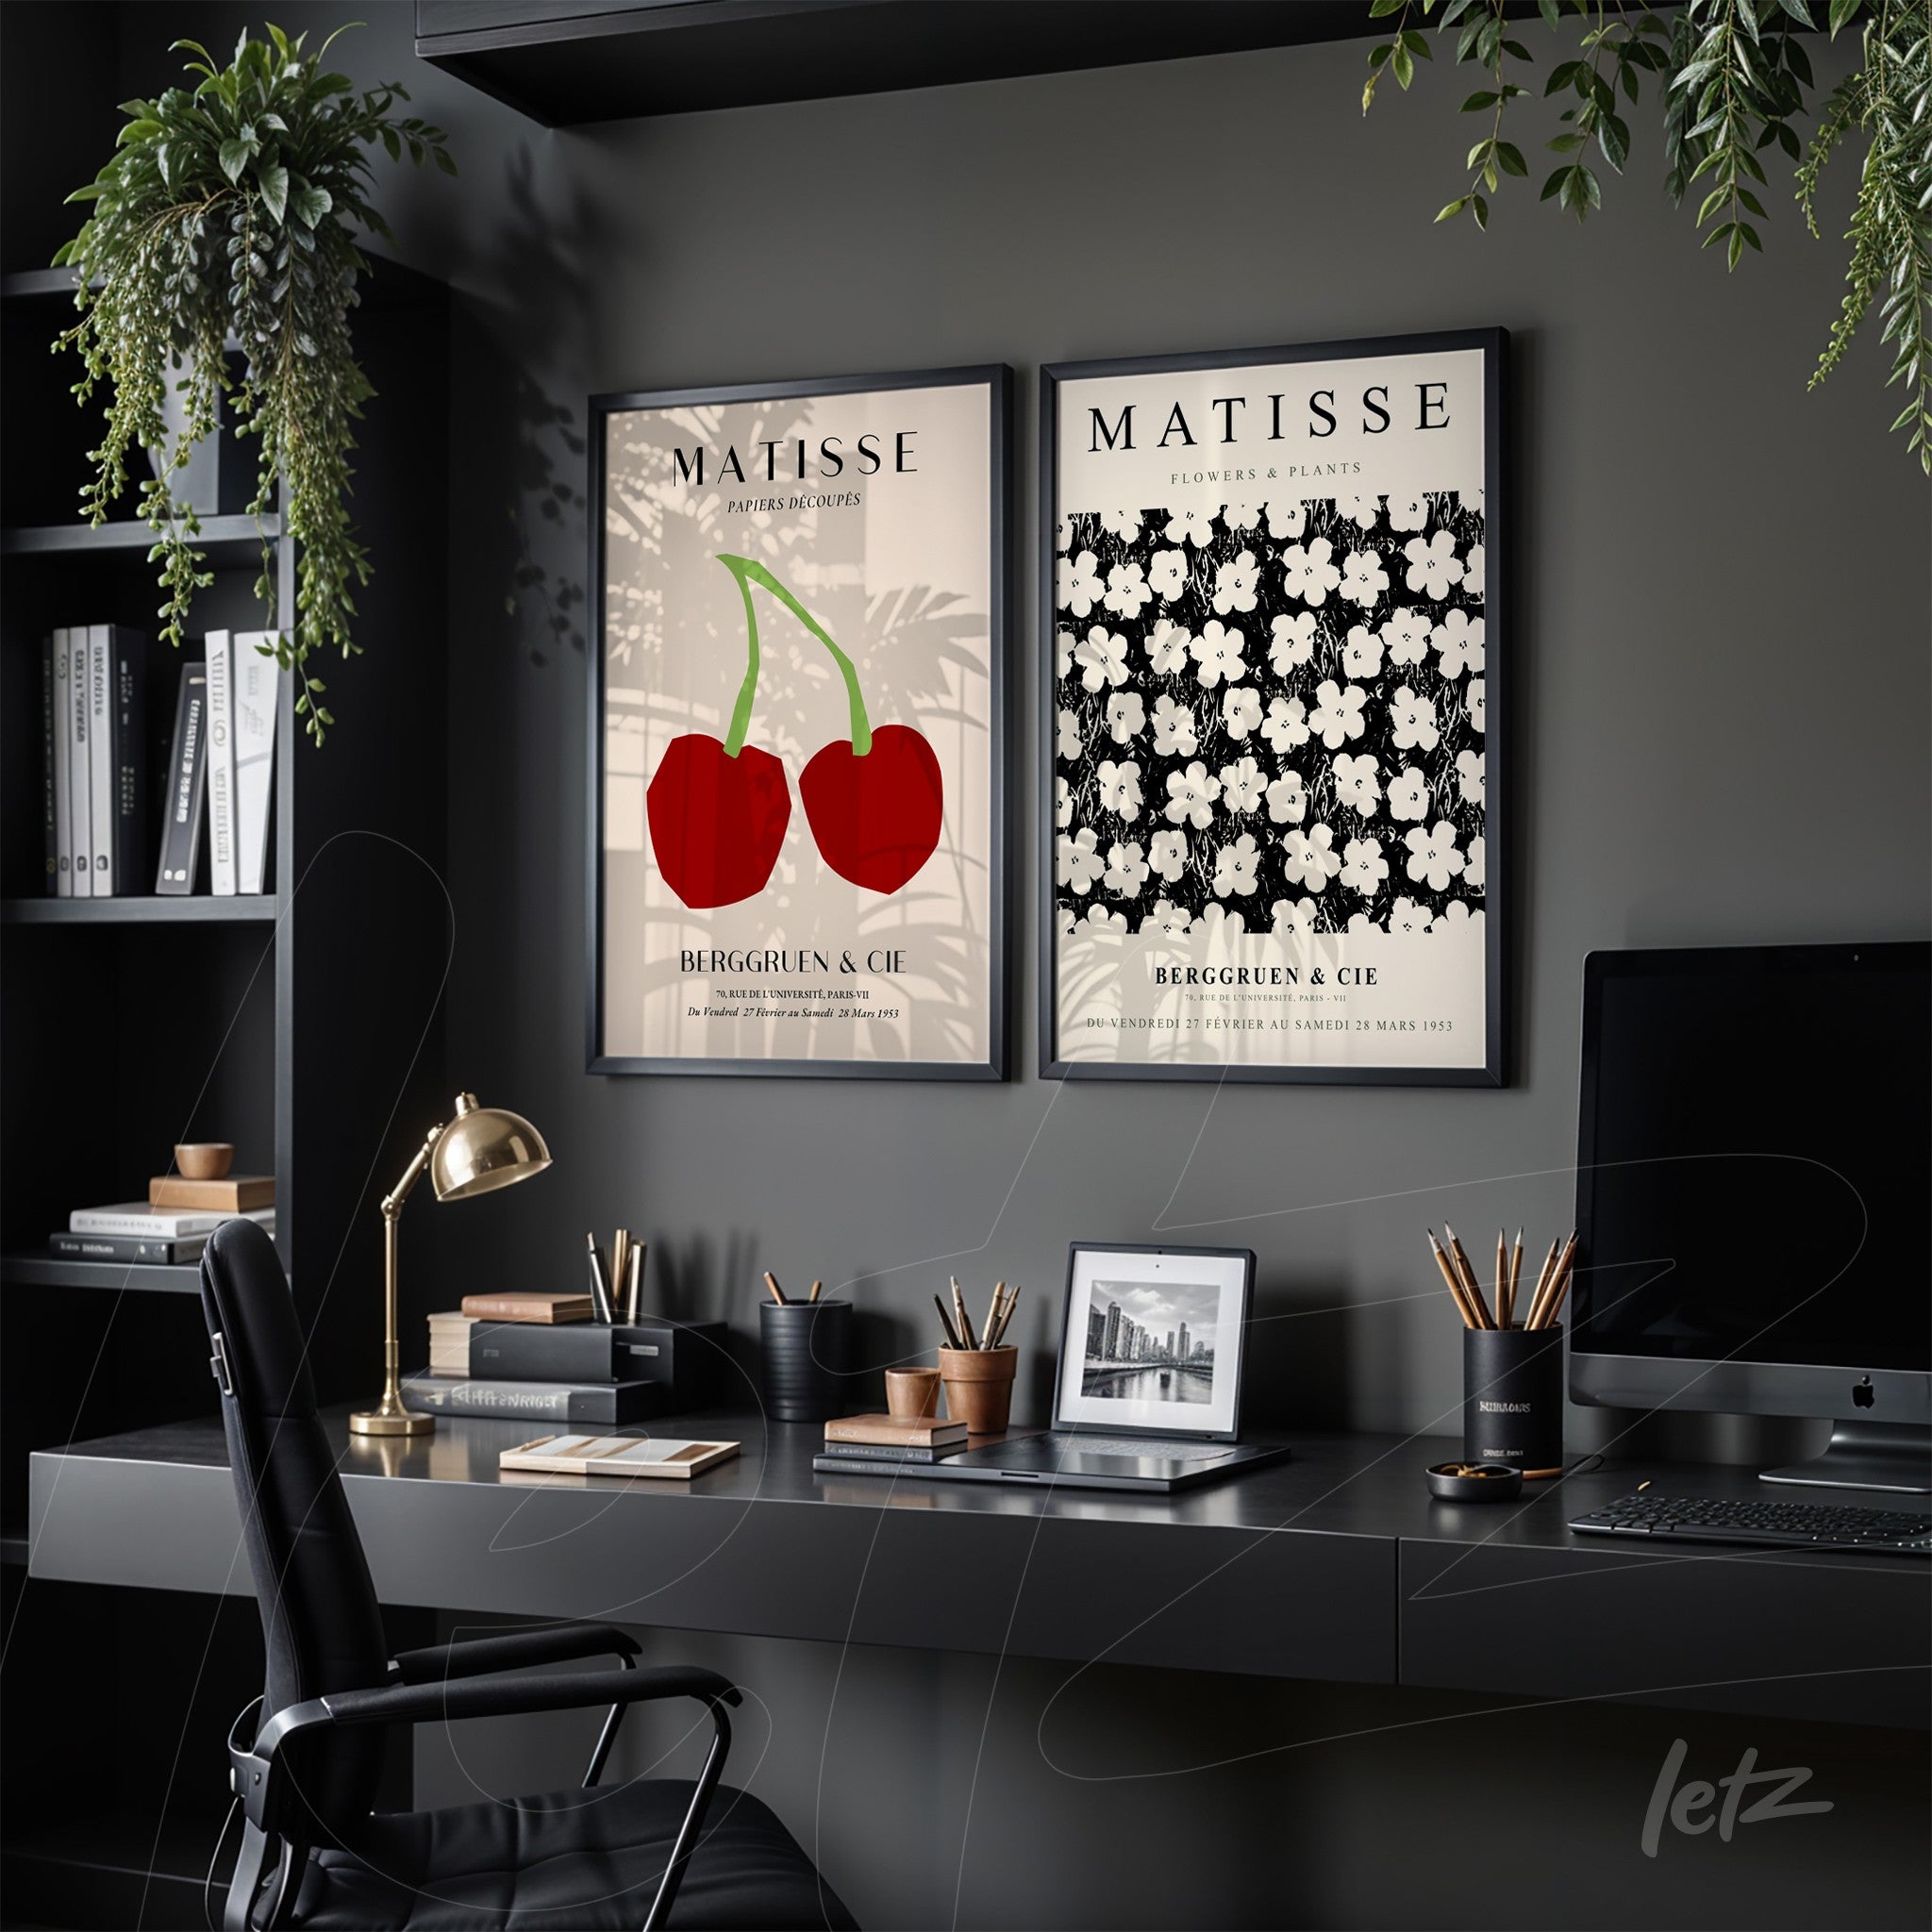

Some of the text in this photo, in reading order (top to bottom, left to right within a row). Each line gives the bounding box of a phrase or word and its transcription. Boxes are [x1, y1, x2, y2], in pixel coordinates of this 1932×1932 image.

[1087, 381, 1452, 453] MATISSE
[674, 431, 919, 487] MATISSE
[1171, 461, 1363, 485] FLOWERS & PLANTS
[727, 497, 785, 513] PAPIERS
[681, 950, 907, 974] BERGGRUEN & CIE
[1156, 967, 1378, 986] BERGGRUEN & CIE
[716, 990, 727, 1000] 70,
[729, 990, 748, 998] RUE
[749, 990, 761, 998] DE
[827, 991, 870, 1000] PARIS-VII
[688, 1007, 700, 1016] Du
[743, 1008, 754, 1017] 27
[801, 1008, 834, 1017] Samedi
[839, 1008, 849, 1018] 28
[851, 1008, 874, 1018] Mars
[877, 1008, 899, 1018] 1953
[1087, 1016, 1453, 1031] DU VENDREDI 27 FÉVRIER AU SAMEDI 28 MARS 1953
